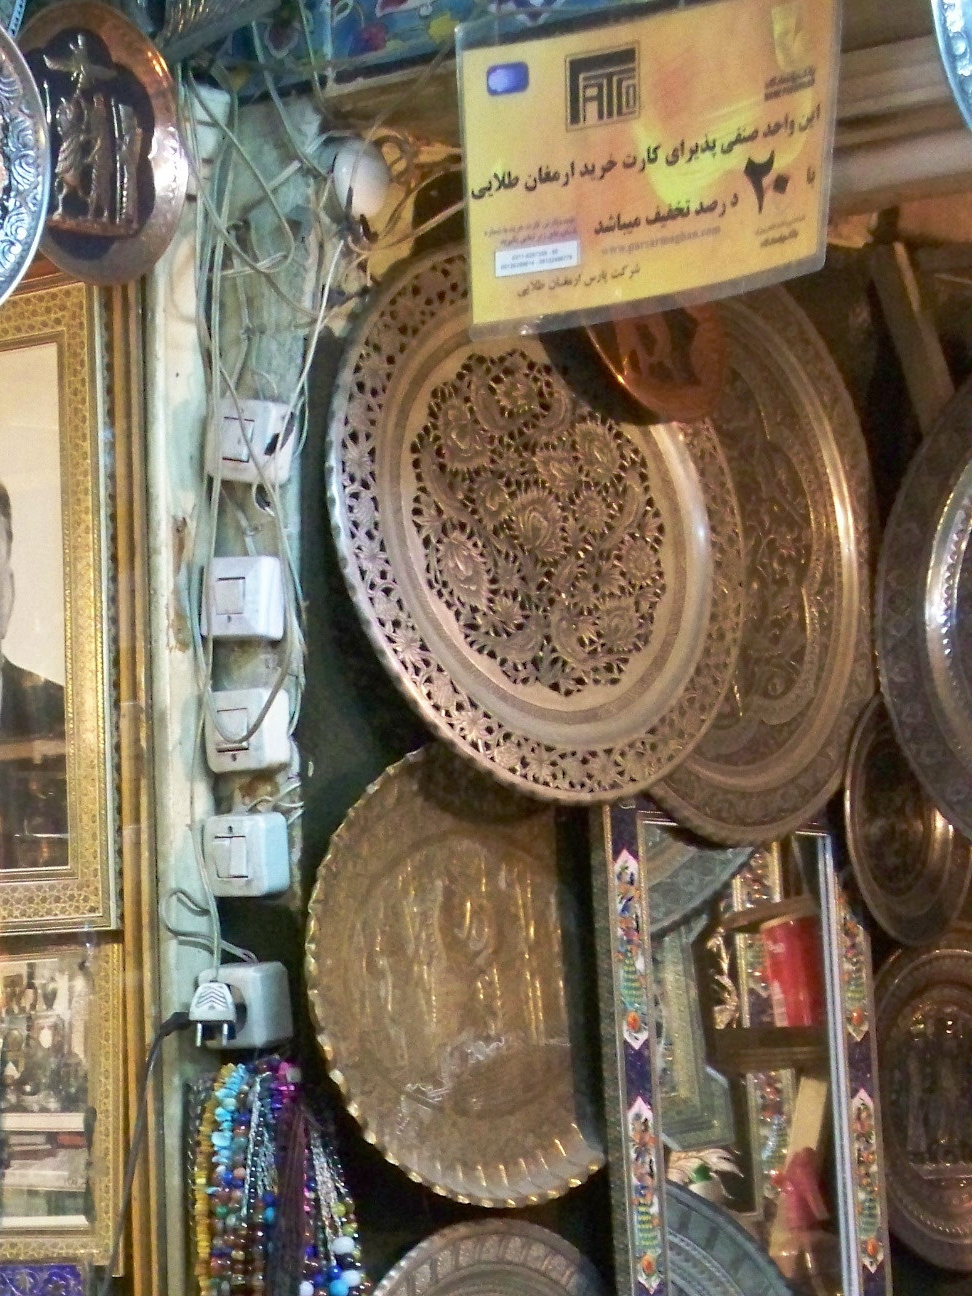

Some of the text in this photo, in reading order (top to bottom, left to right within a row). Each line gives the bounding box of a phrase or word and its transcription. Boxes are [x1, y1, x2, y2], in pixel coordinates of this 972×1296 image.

[470, 103, 821, 200] این واحد صنفی پذیرای کارت خرید ارمغان طلایی
[743, 149, 790, 214] ۲۰
[594, 212, 641, 236] میباشد
[645, 199, 690, 229] تخفیف
[584, 270, 608, 287] پارس
[610, 263, 641, 280] شرکت
